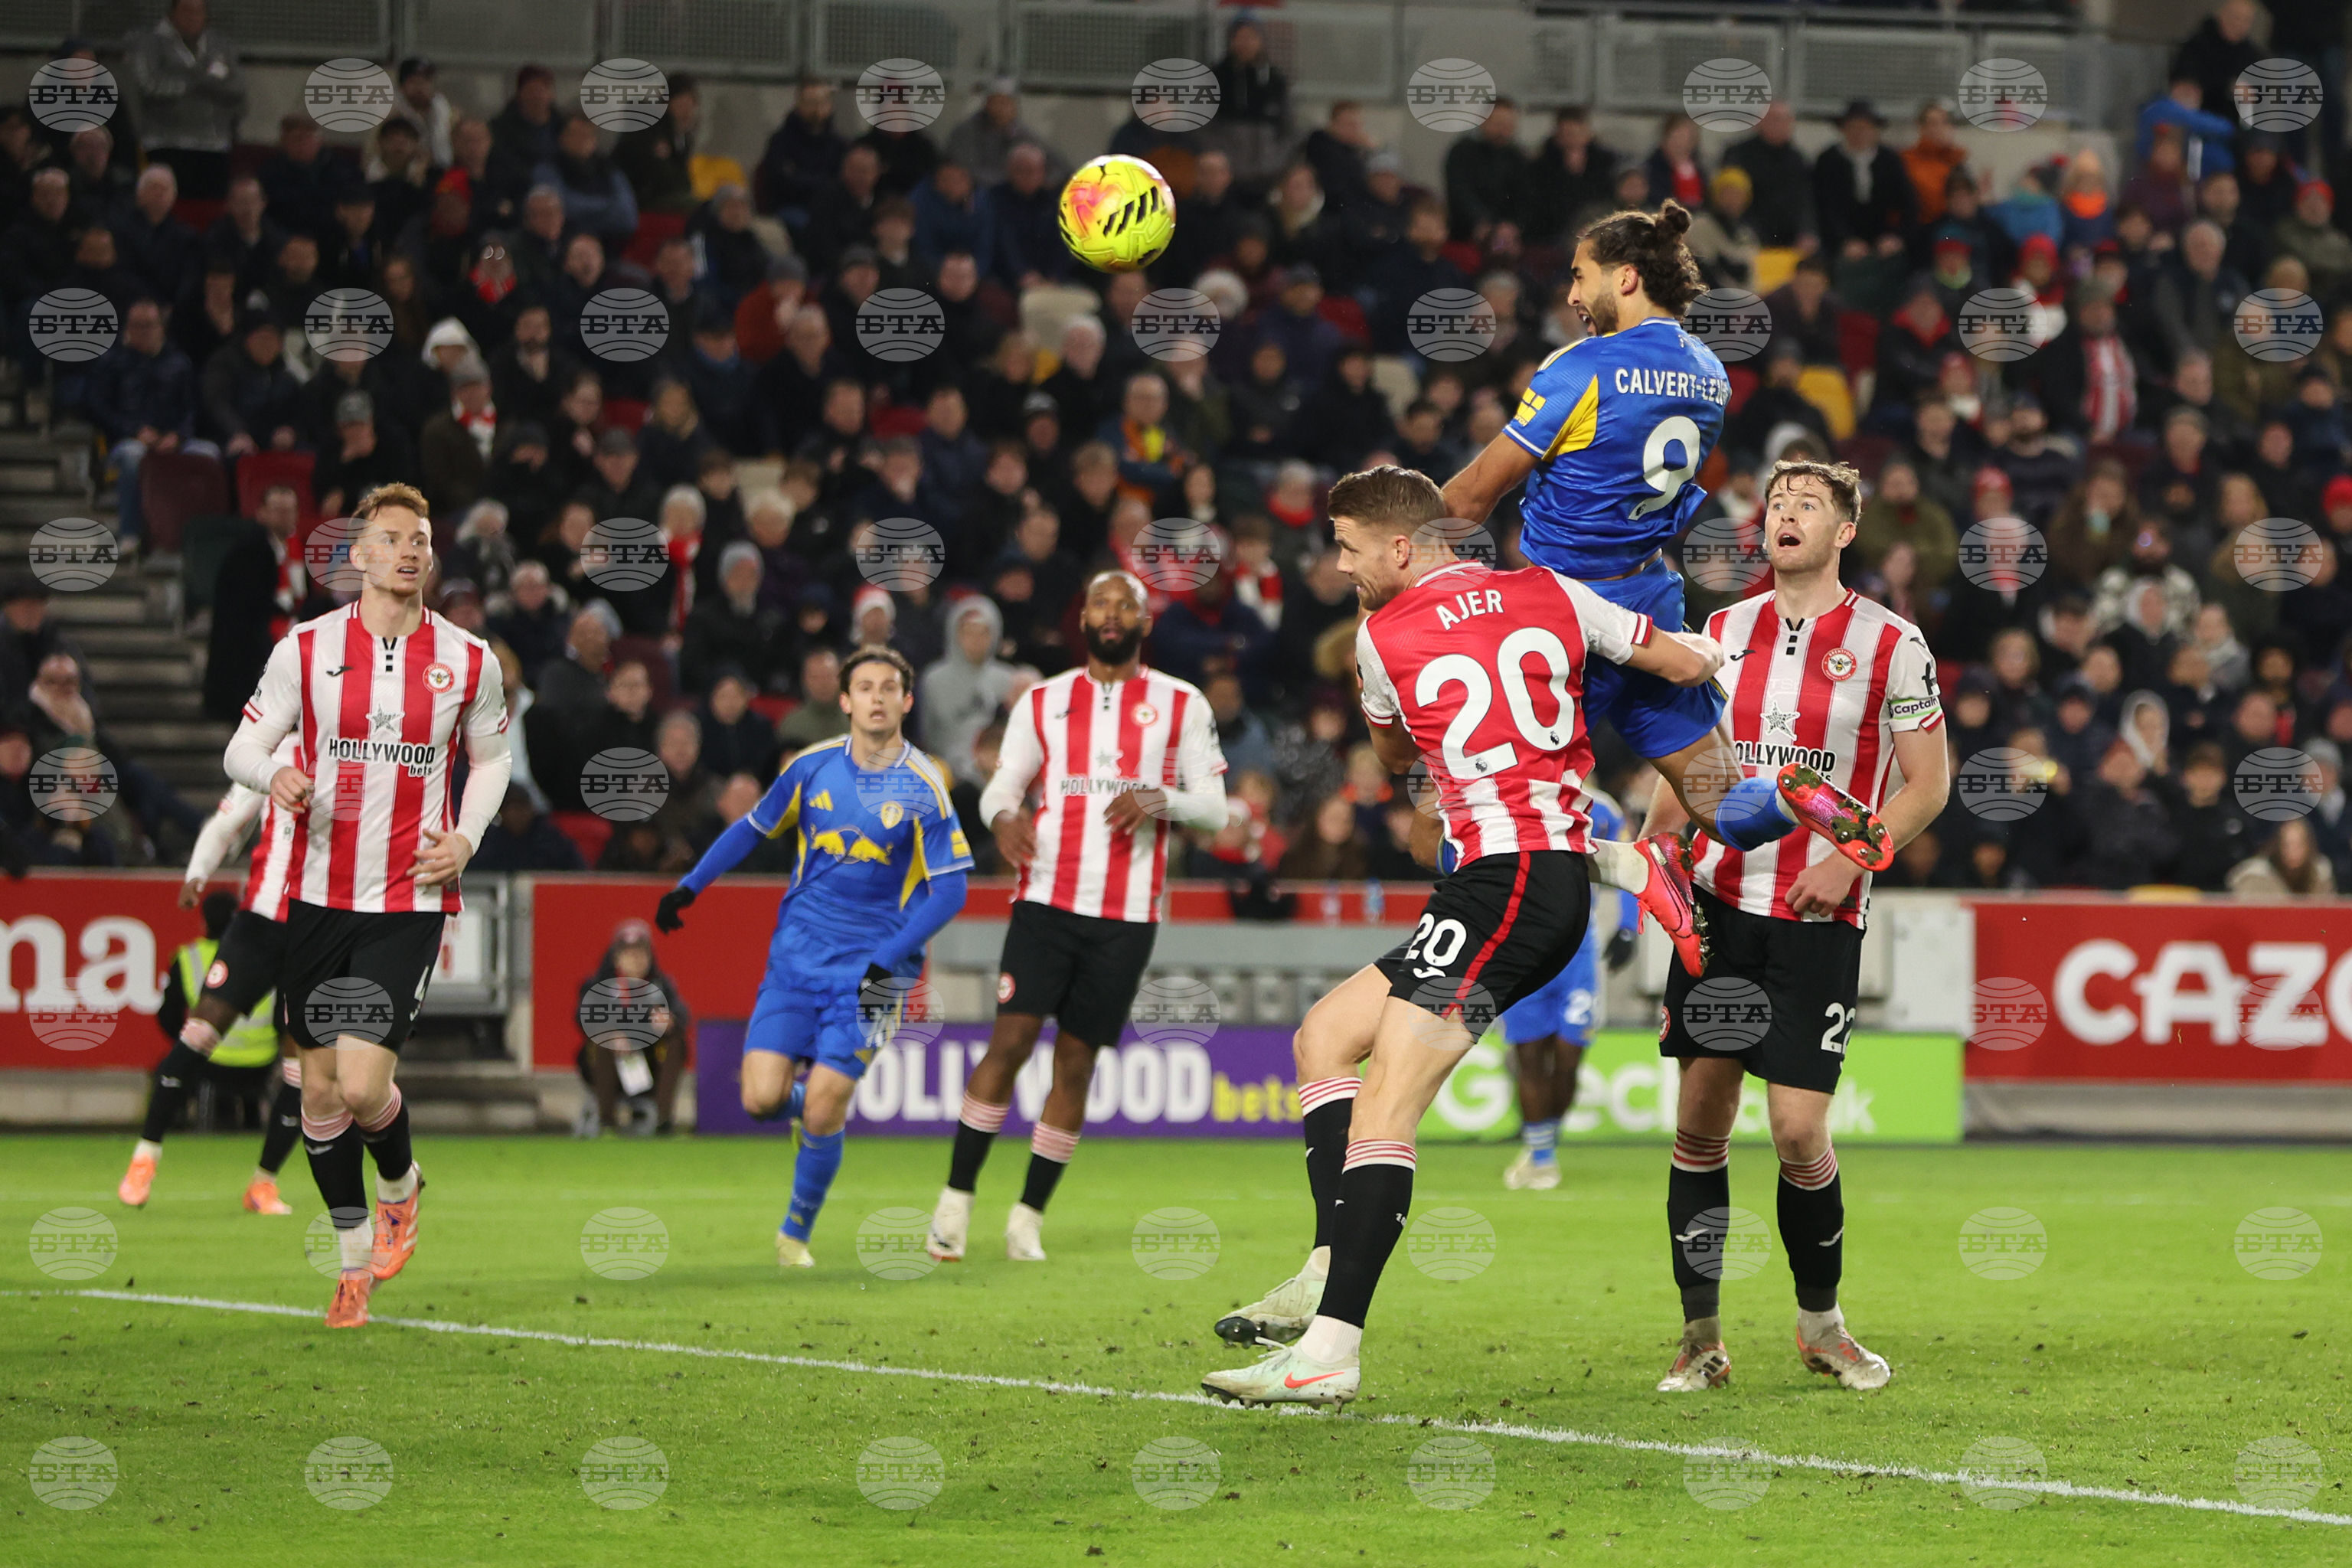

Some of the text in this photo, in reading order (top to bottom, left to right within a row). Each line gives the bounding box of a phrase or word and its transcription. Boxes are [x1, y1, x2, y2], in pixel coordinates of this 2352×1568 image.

[1628, 416, 1700, 521] 9
[1436, 590, 1504, 630] AJER
[1415, 627, 1576, 780] 20
[329, 738, 436, 765] HOLLYWOOD
[1735, 742, 1836, 772] OLLYWOOD
[410, 764, 433, 776] bets
[1060, 778, 1148, 795] HOLLYWO
[1404, 913, 1467, 967] 20
